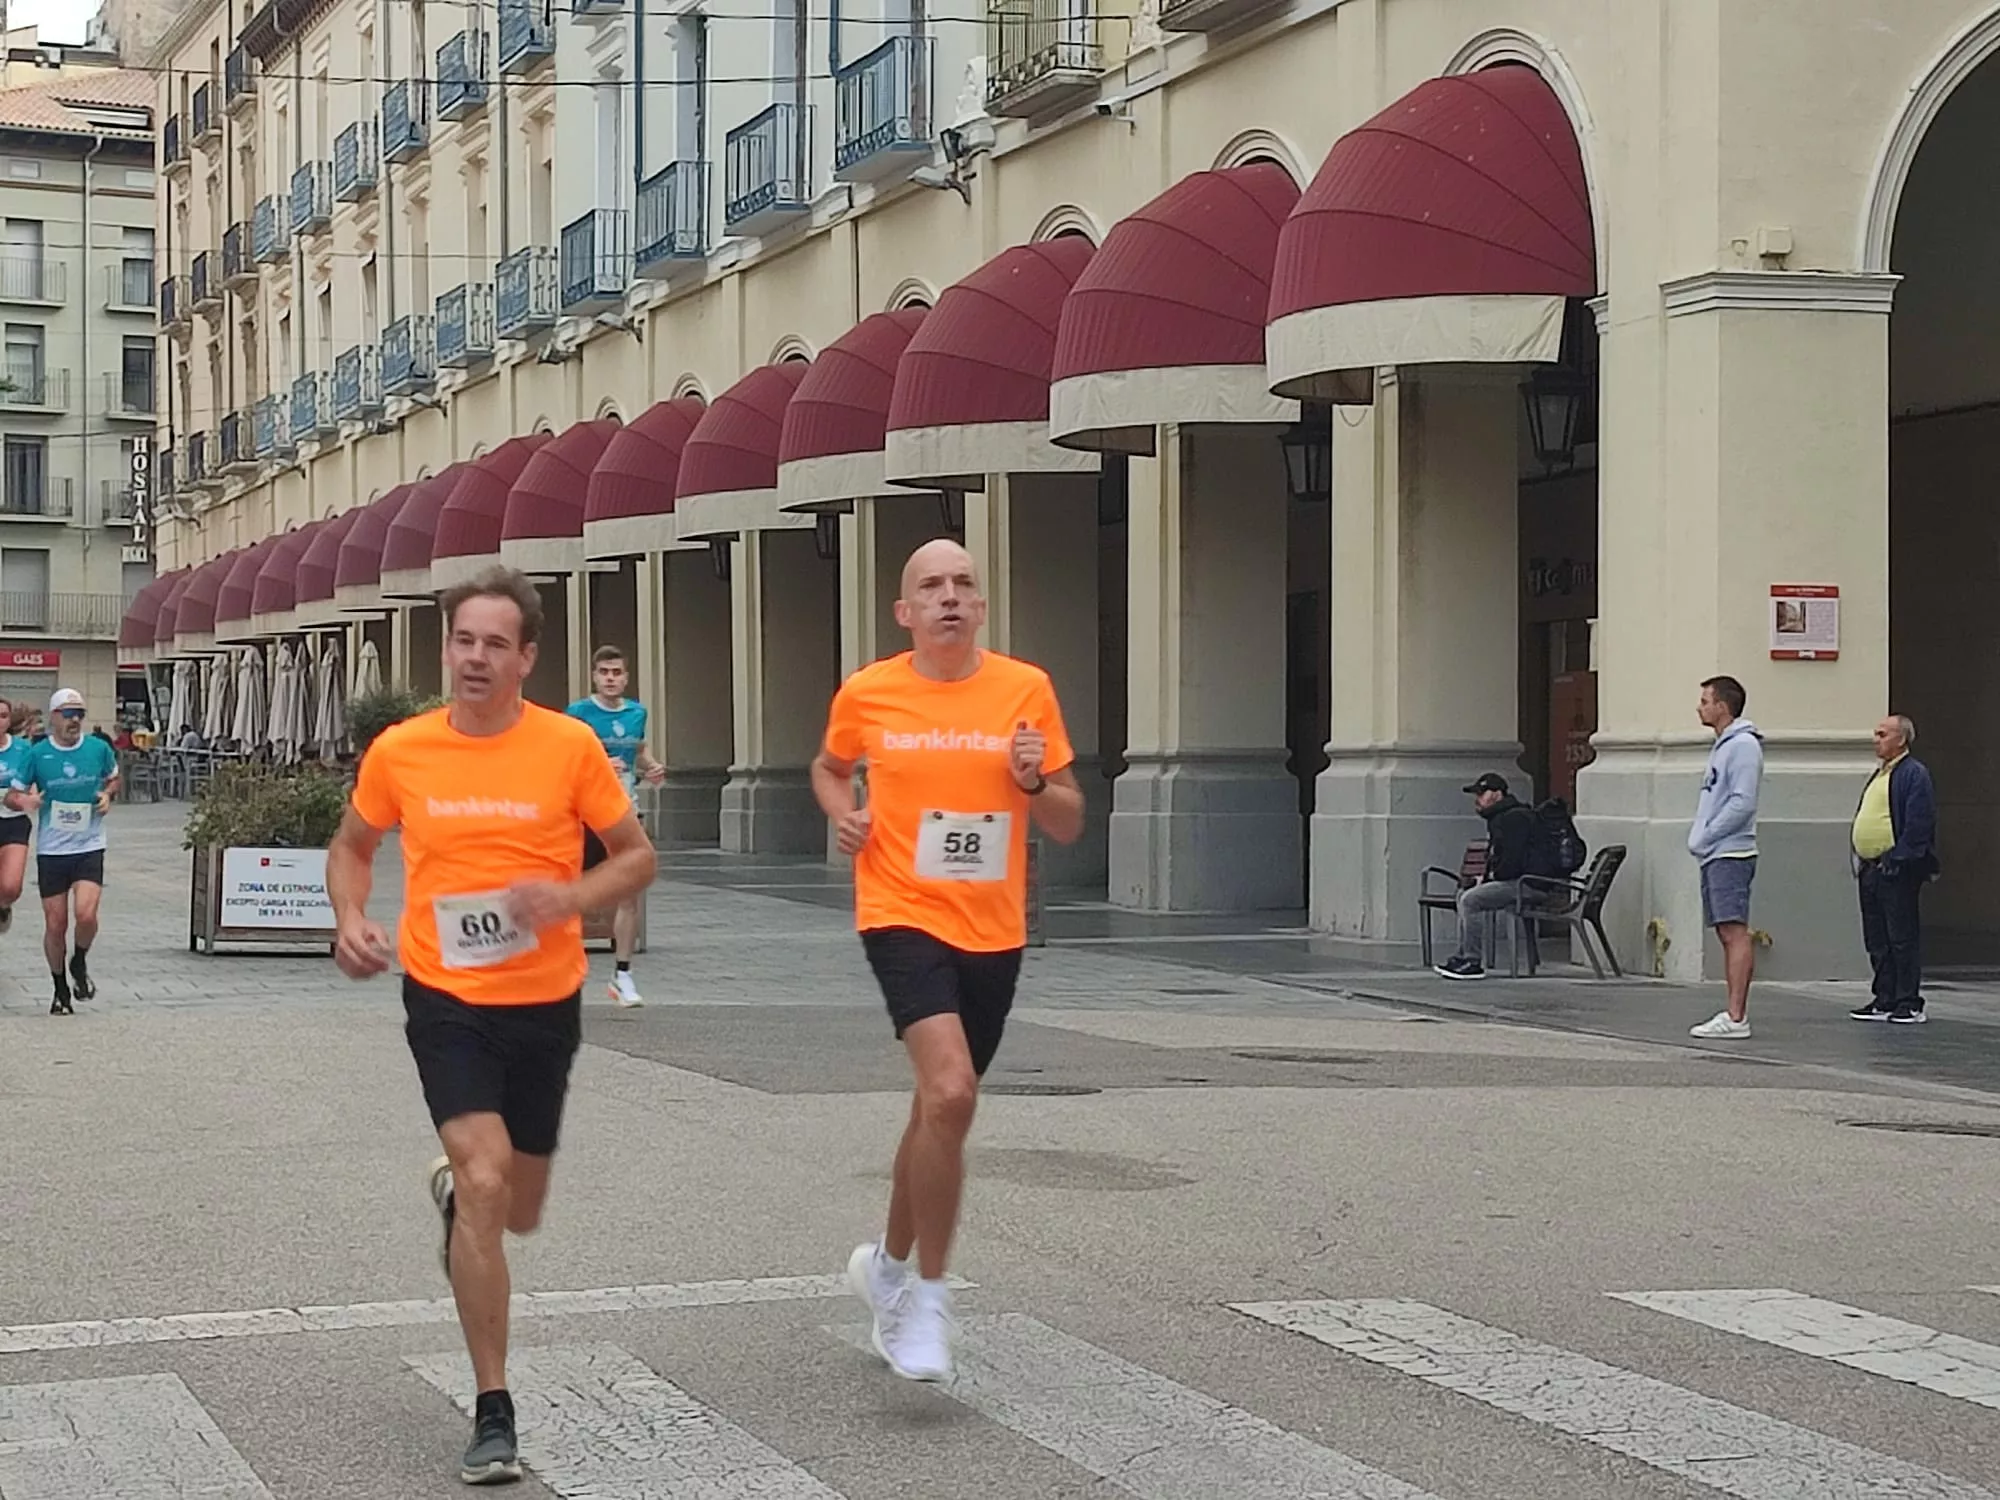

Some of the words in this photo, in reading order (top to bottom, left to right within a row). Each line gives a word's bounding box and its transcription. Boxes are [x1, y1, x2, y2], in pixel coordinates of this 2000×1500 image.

[132, 436, 148, 543] HOSTAL
[13, 653, 44, 665] GAES
[943, 832, 981, 854] 58
[238, 882, 265, 893] ZONA
[267, 884, 279, 893] DE
[282, 884, 325, 894] ESTANCIA
[261, 899, 288, 907] CARGA
[461, 911, 501, 938] 60
